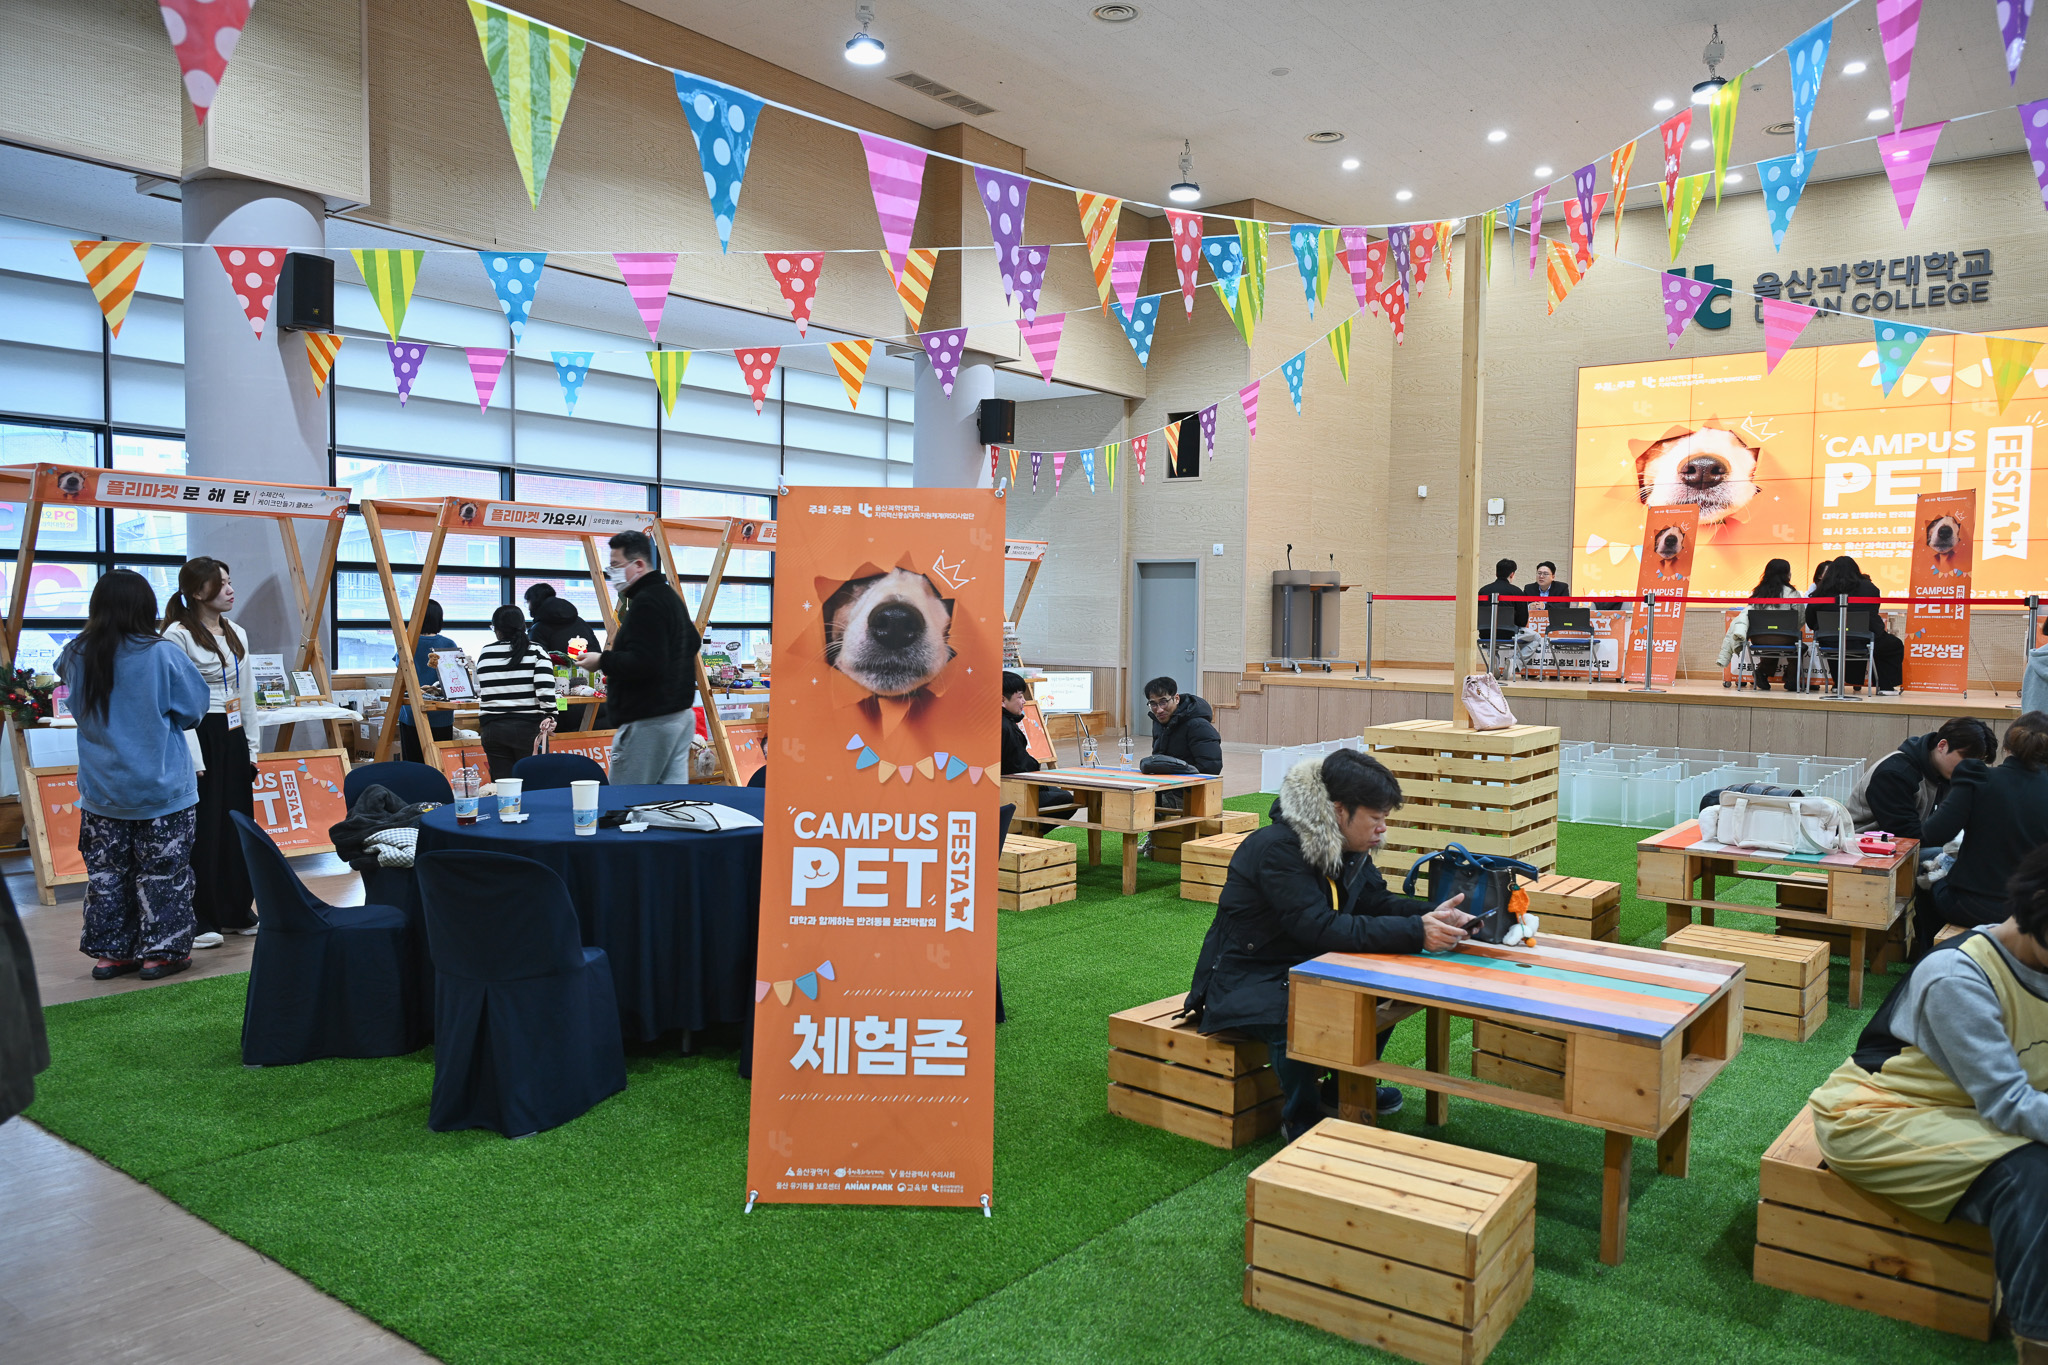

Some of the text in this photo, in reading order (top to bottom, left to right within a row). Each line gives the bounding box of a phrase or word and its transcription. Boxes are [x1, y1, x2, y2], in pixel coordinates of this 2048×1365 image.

[1753, 249, 1993, 301] 울산과학대학교
[1852, 281, 1990, 312] COLLEGE
[1825, 429, 1976, 457] CAMPUS
[1823, 457, 1976, 507] PET
[1991, 435, 2023, 519] FESTA
[106, 480, 251, 504] 플리마켓 문 해 담
[54, 510, 75, 521] PC
[490, 508, 540, 524] 플리마켓
[541, 512, 588, 527] 가요우시
[1915, 586, 1955, 595] CAMPUS
[1910, 643, 1965, 659] 건강상담
[282, 773, 299, 811] FESTA
[793, 811, 939, 841] CAMPUS
[950, 819, 971, 895] FESTA
[791, 846, 938, 908] PET
[789, 915, 817, 925] 대학과
[819, 916, 855, 926] 함께하는
[789, 1014, 968, 1076] 체험존
[796, 1167, 830, 1177] 울산광역시
[871, 1183, 893, 1192] PARK
[907, 1183, 927, 1192] 교육부
